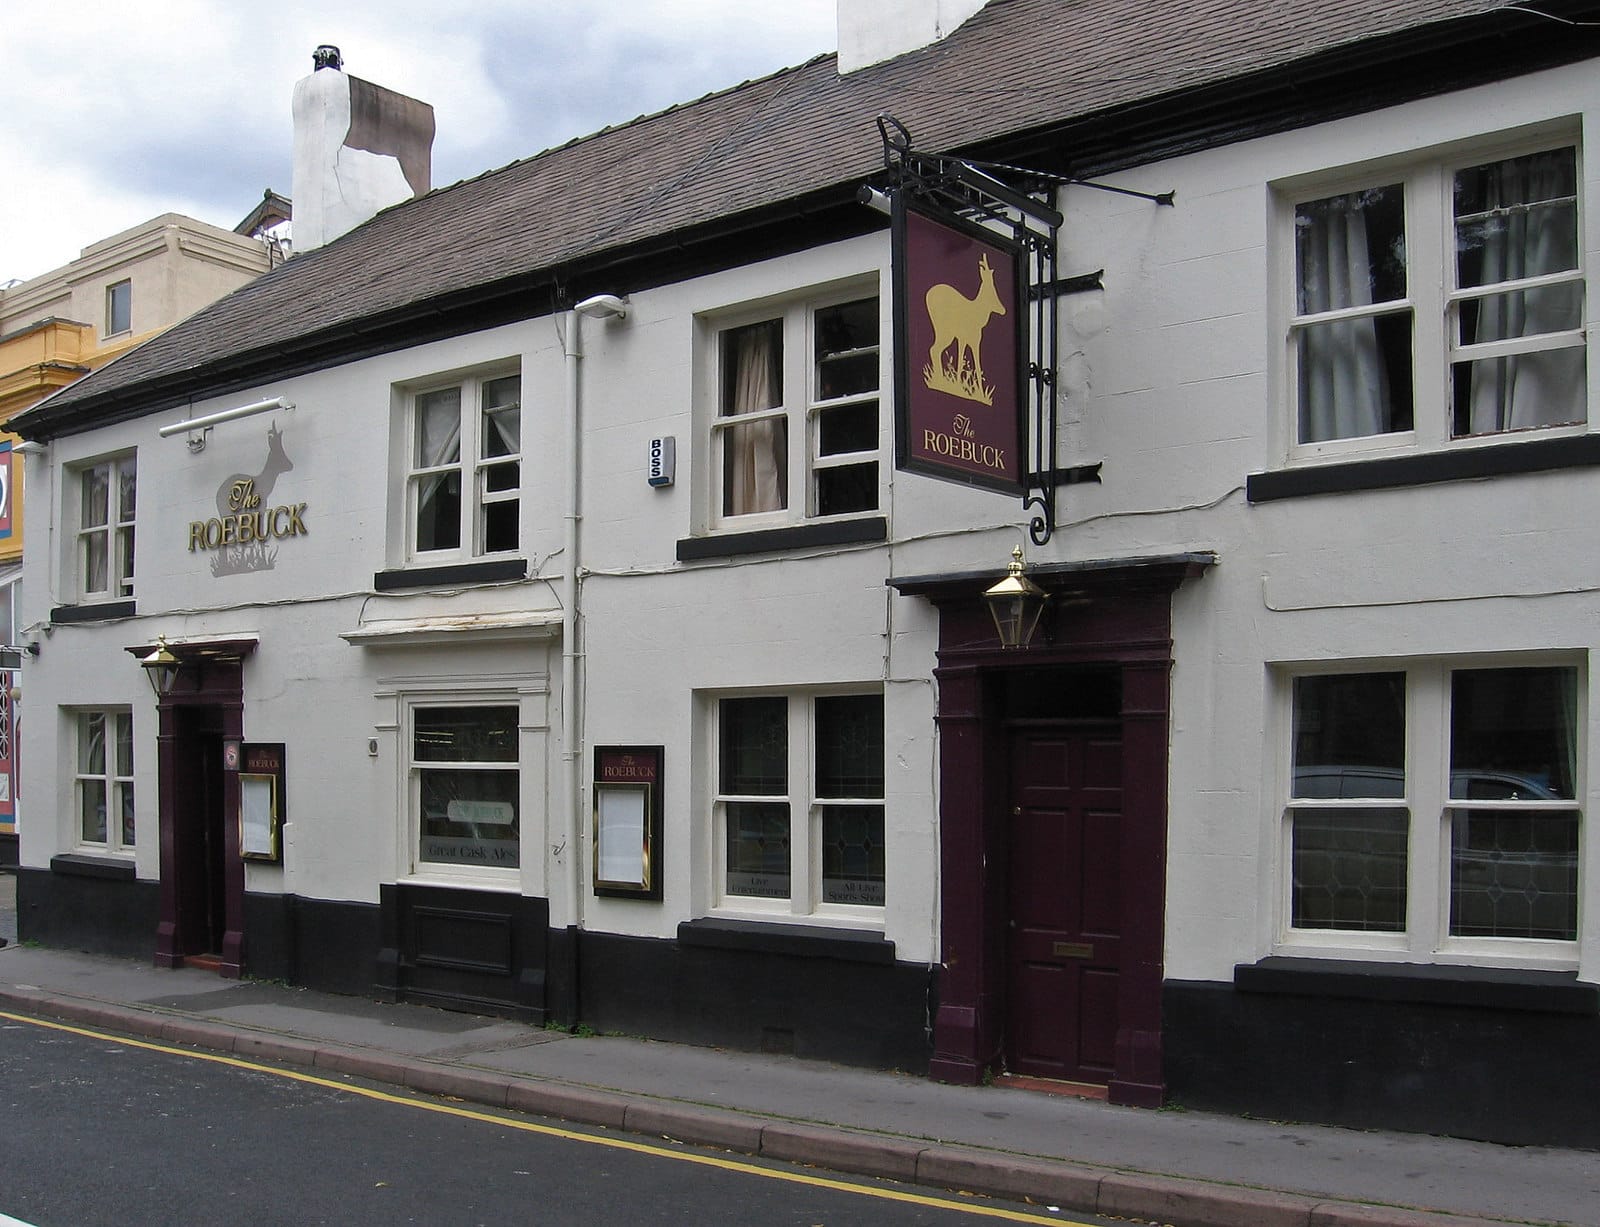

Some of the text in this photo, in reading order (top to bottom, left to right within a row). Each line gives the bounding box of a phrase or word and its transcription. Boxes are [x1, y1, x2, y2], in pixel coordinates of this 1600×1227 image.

[952, 413, 976, 439] The
[651, 439, 662, 477] BOSS
[923, 429, 1006, 470] ROEBUCK
[228, 478, 261, 512] The
[188, 502, 308, 552] ROEBUCK
[604, 766, 655, 777] ROEBUCK
[429, 847, 456, 857] Great
[459, 847, 487, 859] Cask
